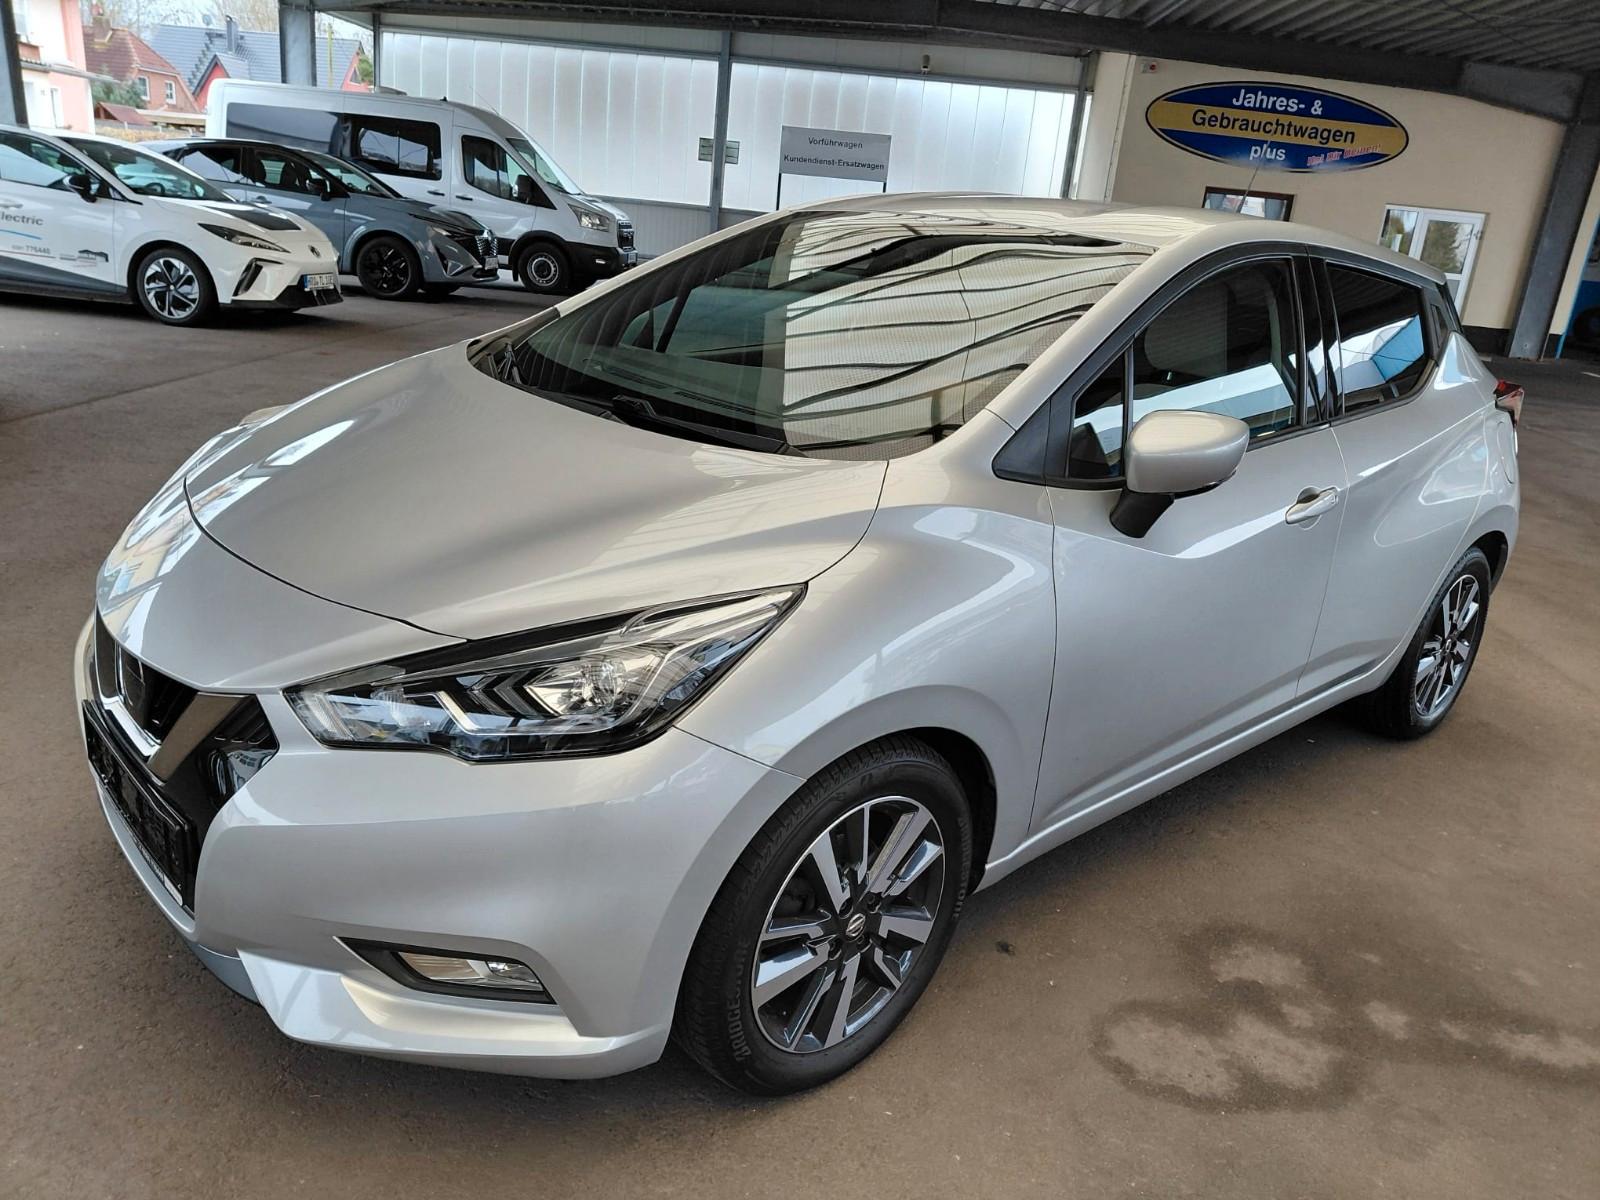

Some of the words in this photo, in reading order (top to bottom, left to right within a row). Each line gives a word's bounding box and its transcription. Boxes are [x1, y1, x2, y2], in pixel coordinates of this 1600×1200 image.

[1232, 88, 1305, 112] Jahres-
[1311, 99, 1323, 115] &
[1192, 108, 1356, 145] Gebrauchtwagen
[808, 136, 863, 150] Vorführwagen
[1249, 143, 1287, 161] plus
[783, 154, 885, 171] Kundendienst-Ersatzwagen
[0, 211, 44, 226] lectric
